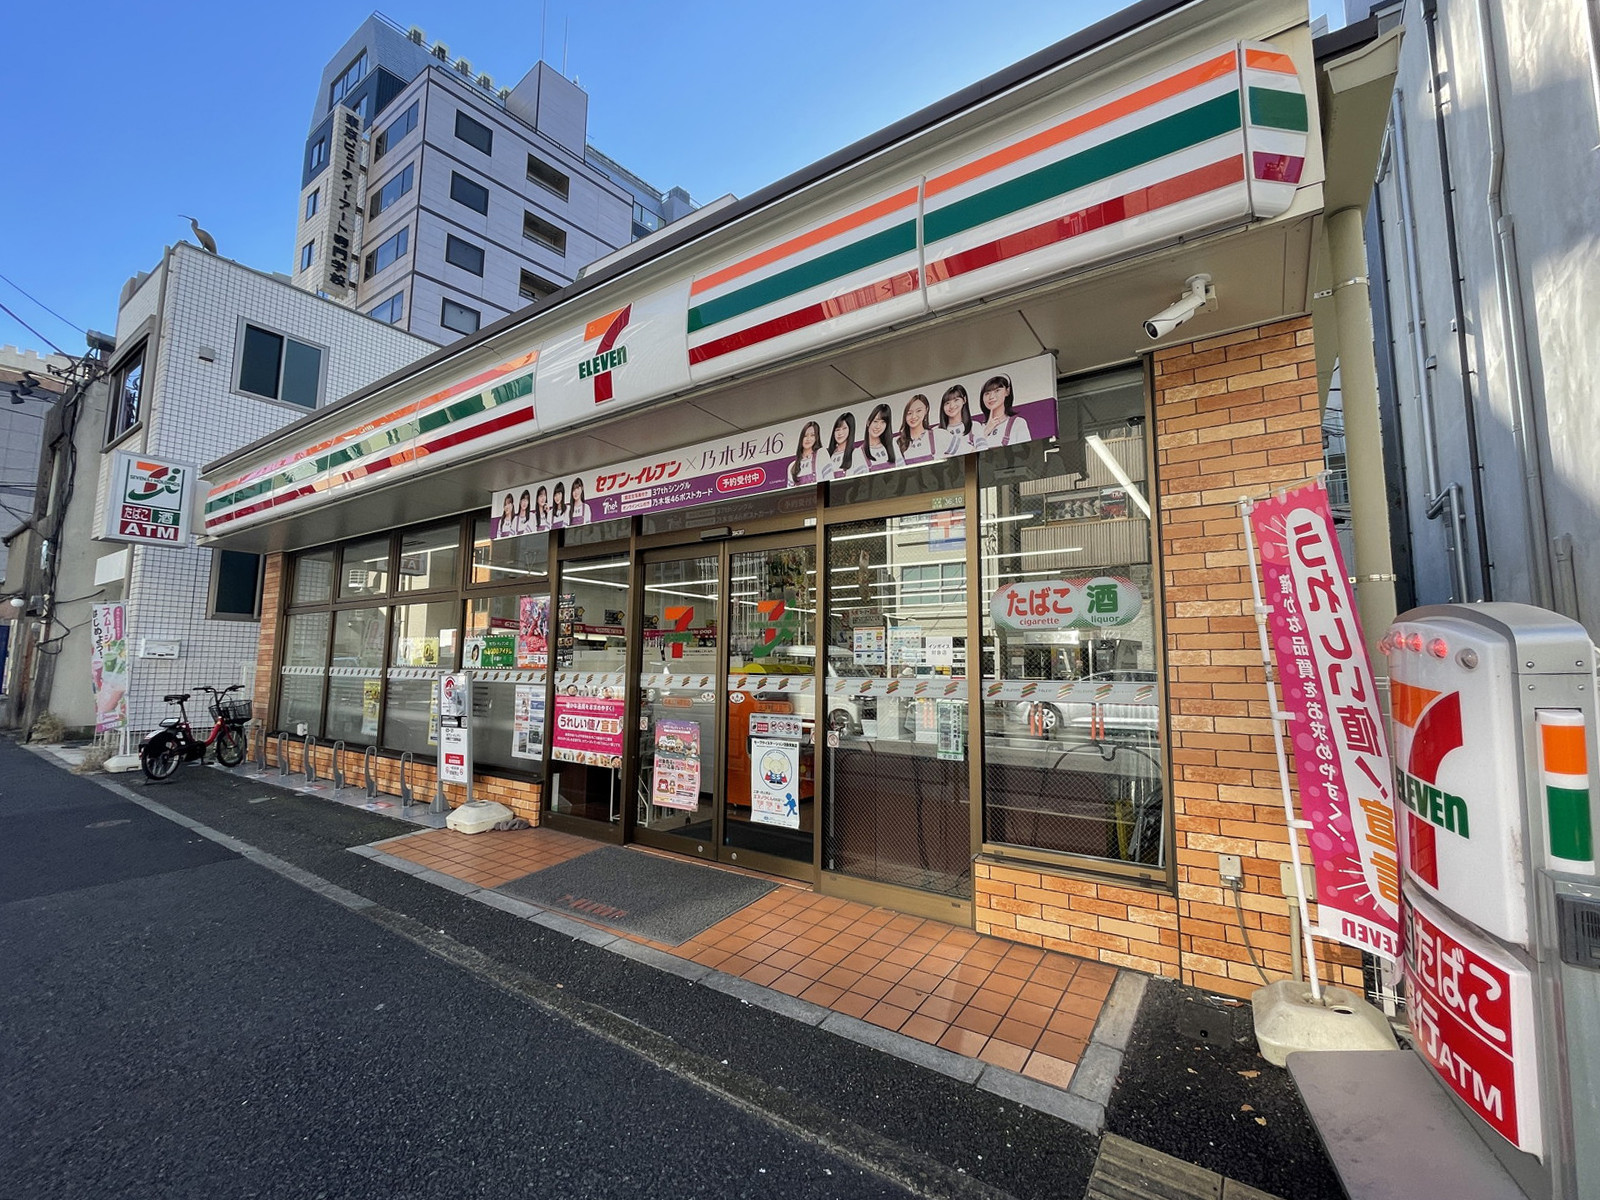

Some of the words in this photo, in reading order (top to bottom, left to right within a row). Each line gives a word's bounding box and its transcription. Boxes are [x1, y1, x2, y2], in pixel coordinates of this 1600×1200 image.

[700, 432, 785, 471] 乃木坂46
[652, 481, 692, 497] 37thシングル
[722, 472, 760, 489] 予約受付中
[652, 487, 714, 507] 乃木坂46ポストカード
[124, 506, 149, 521] たばこ
[157, 511, 175, 525] 酒
[124, 522, 176, 540] ATM
[1006, 586, 1074, 618] たばこ
[1086, 583, 1119, 614] 酒
[102, 607, 113, 652] スムージー
[1019, 616, 1060, 627] cigarette
[1091, 614, 1121, 625] liquor
[1416, 919, 1508, 1043] たばこ
